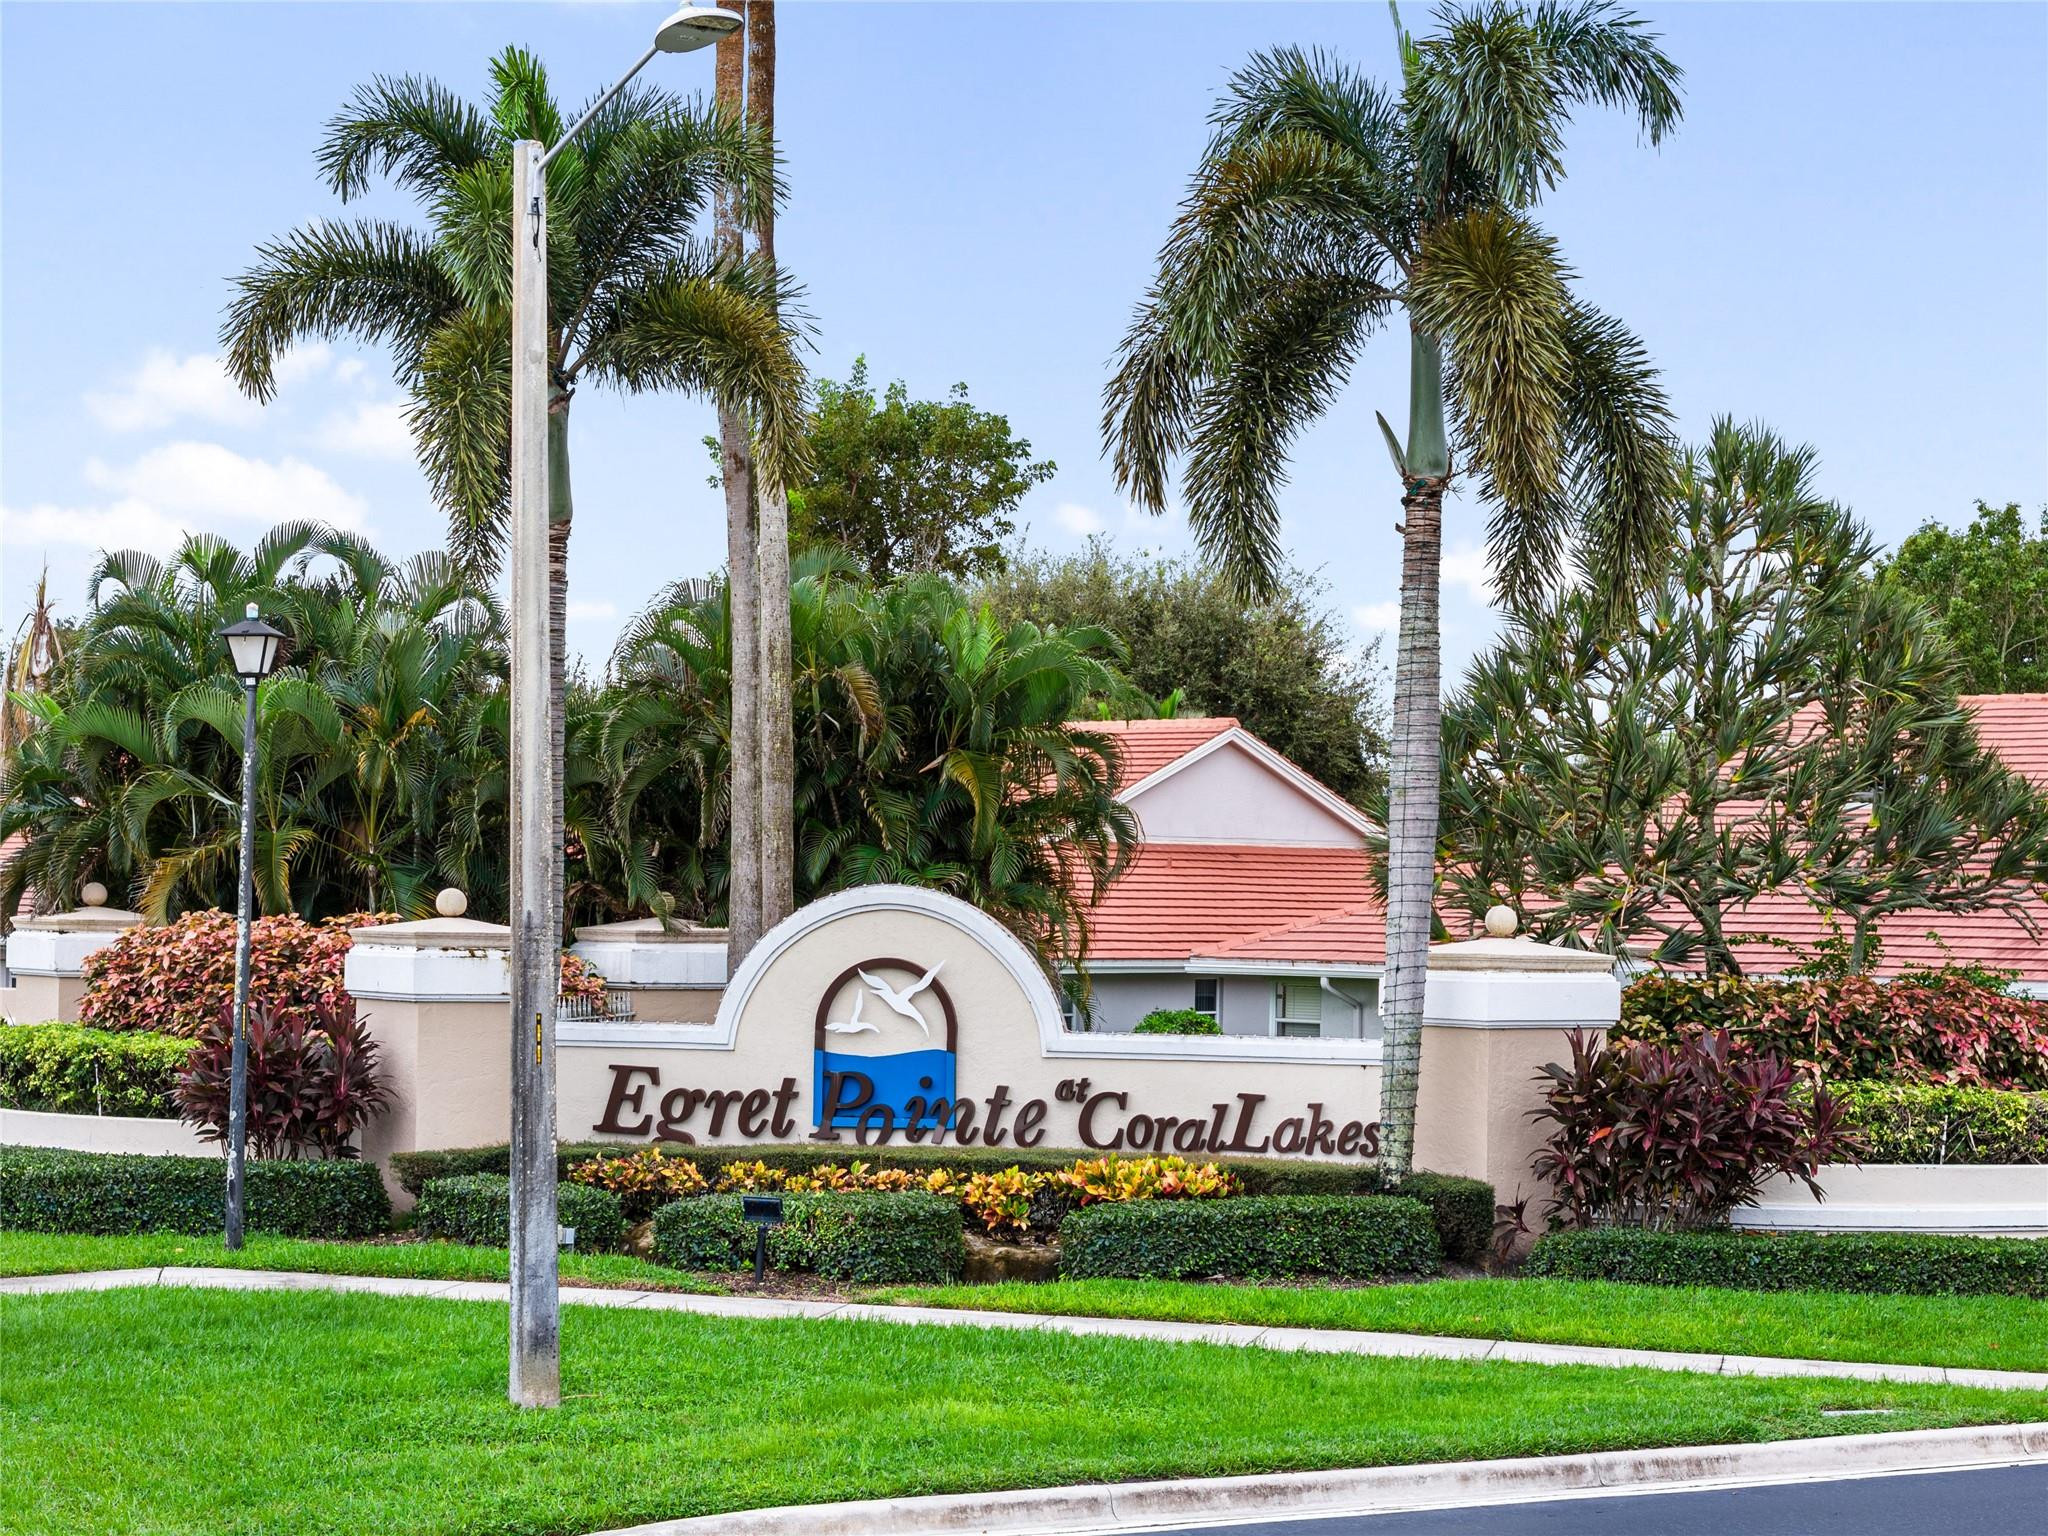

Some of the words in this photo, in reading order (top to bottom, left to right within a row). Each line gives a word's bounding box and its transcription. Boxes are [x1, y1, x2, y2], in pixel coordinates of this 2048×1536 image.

[592, 1064, 799, 1146] Egret
[809, 1070, 1048, 1149] Pointe
[1055, 1078, 1092, 1103] at
